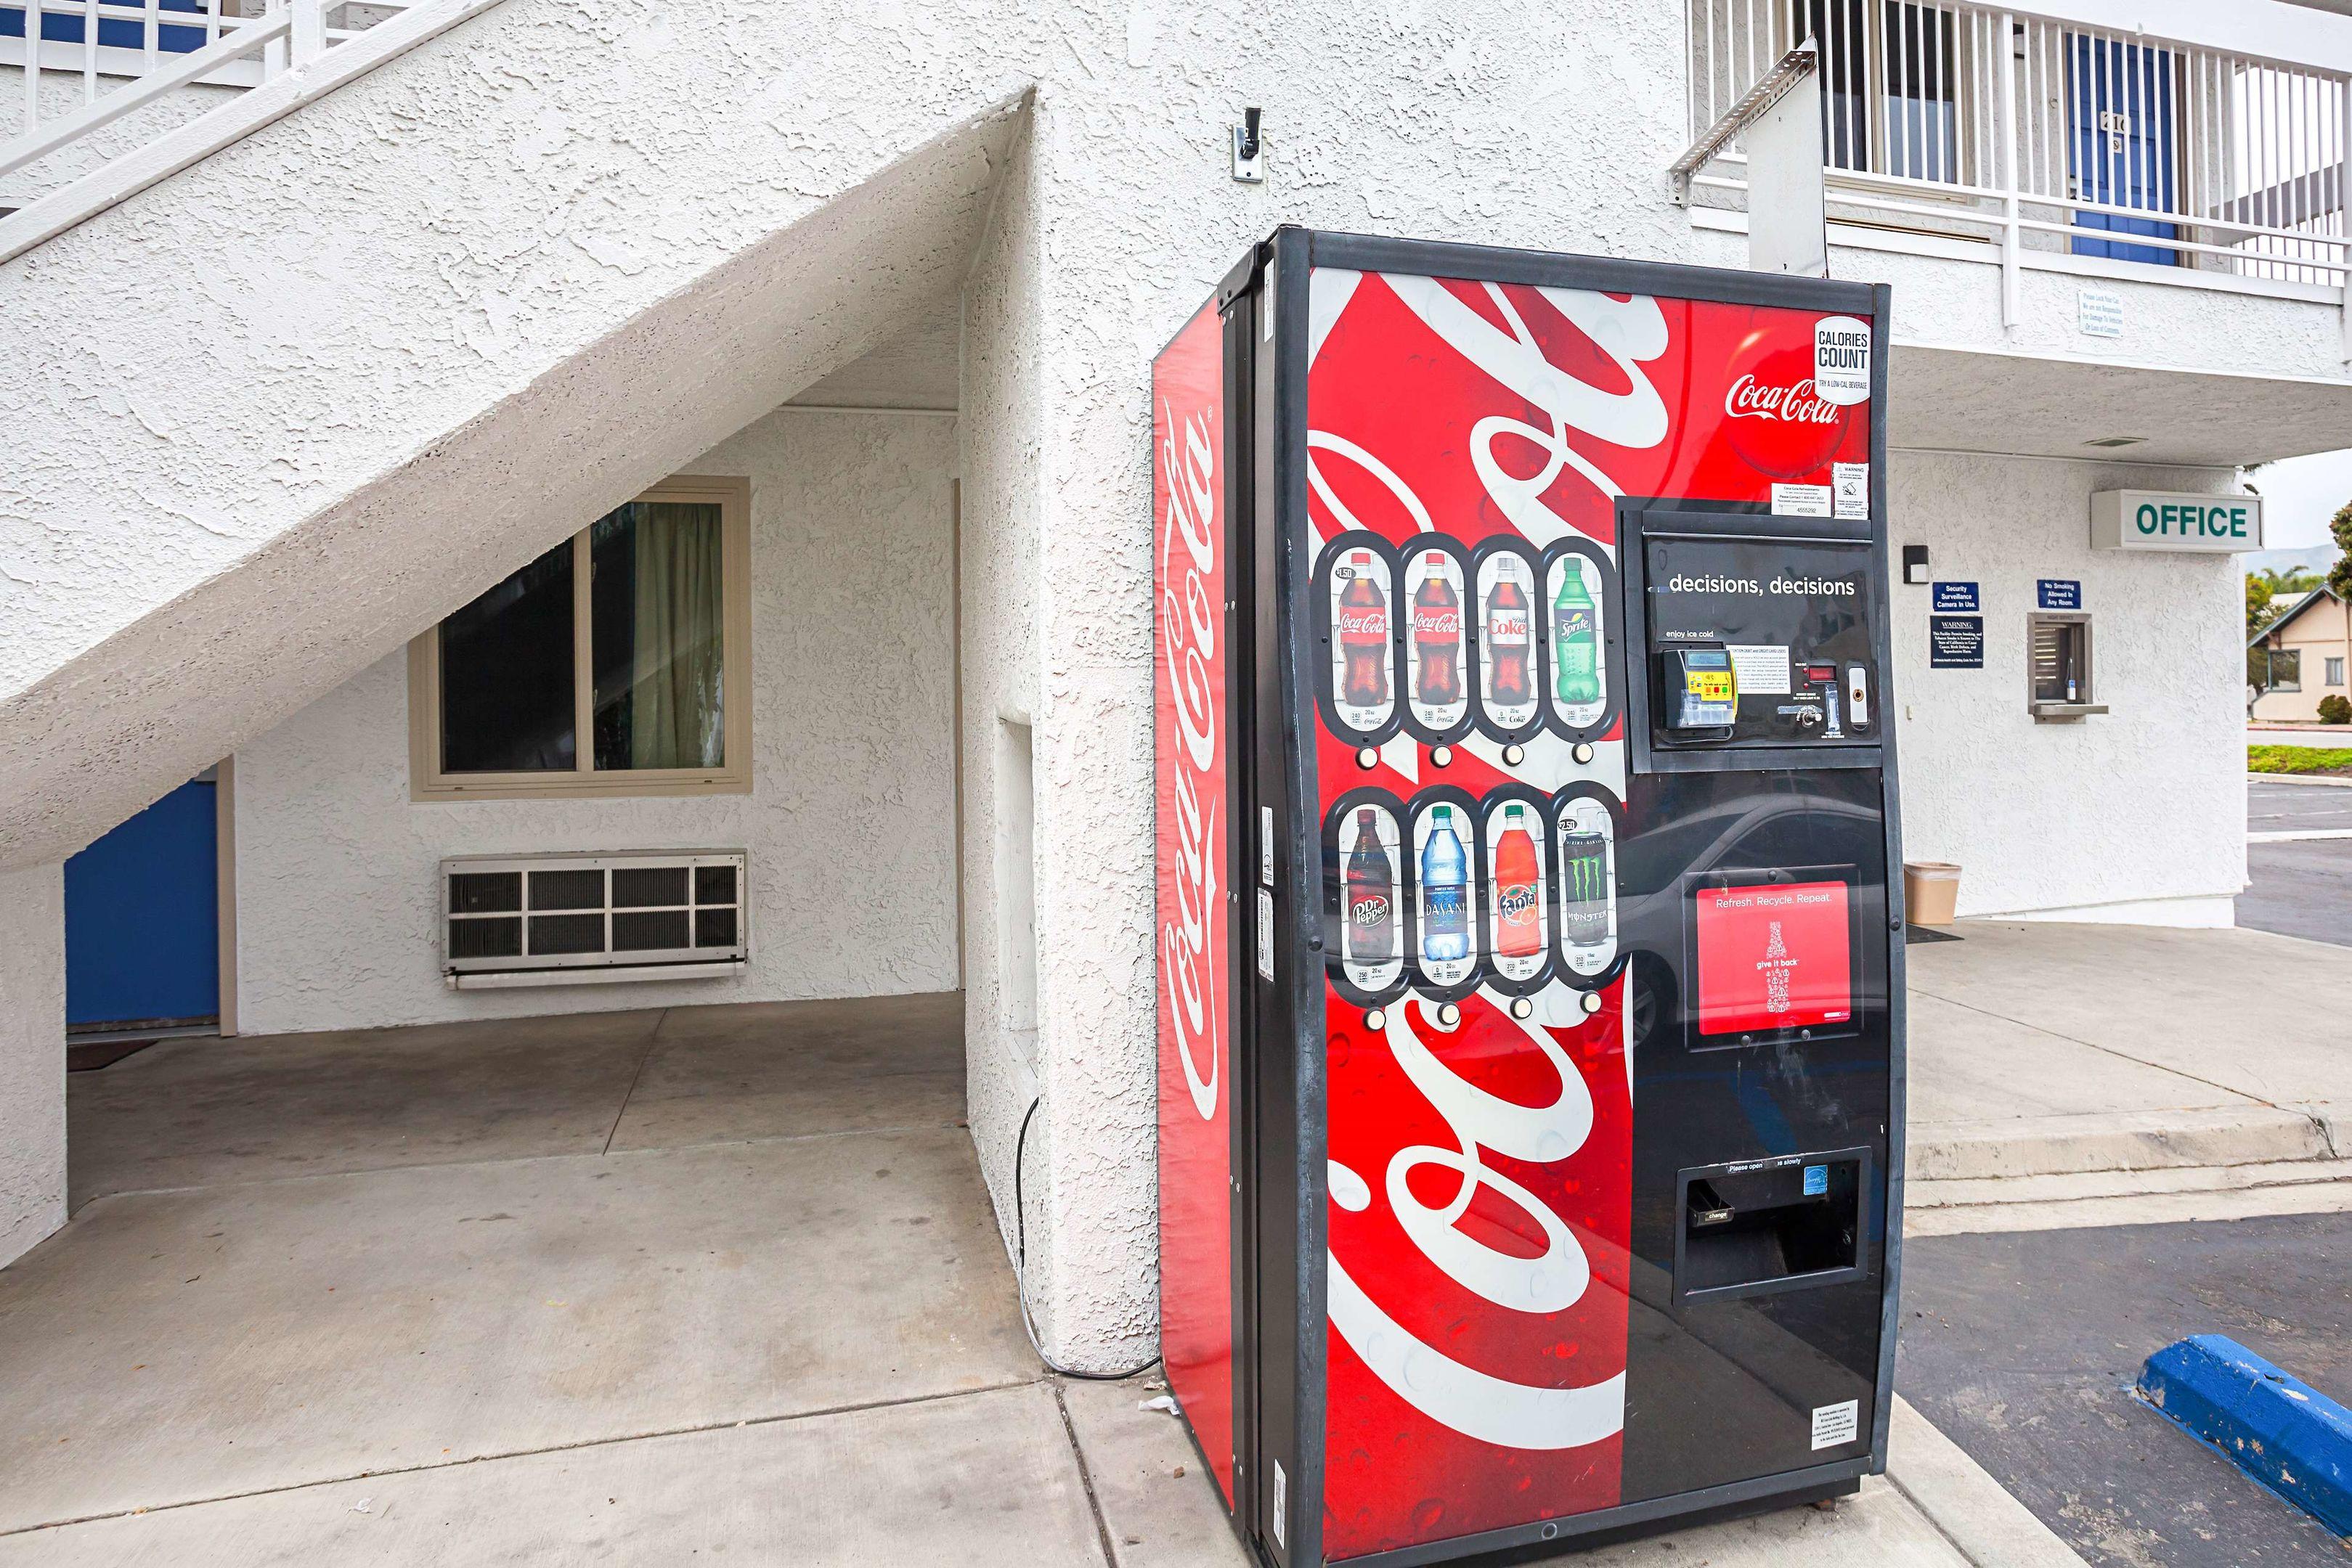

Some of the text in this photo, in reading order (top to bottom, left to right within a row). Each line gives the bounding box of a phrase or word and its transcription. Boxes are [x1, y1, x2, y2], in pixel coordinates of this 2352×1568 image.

[1818, 330, 1868, 348] CALORIES
[1818, 347, 1868, 369] COUNT
[1849, 381, 1867, 390] BEVERAGE
[2136, 504, 2247, 537] OFFICE
[1336, 568, 1352, 578] $1.50
[1669, 573, 1855, 597] decisions, decisions
[1340, 613, 1385, 634] Coca-Cola
[1415, 613, 1459, 633] Coca-Cola
[1488, 618, 1526, 634] Coke
[1562, 617, 1589, 637] Sprite
[1163, 395, 1217, 1120] Coca-Cola
[1365, 899, 1379, 912] Dr
[1426, 900, 1465, 918] DASANI
[1716, 894, 1832, 908] Refresh. Recycle. Repeat.
[1354, 902, 1387, 924] Pepper
[1568, 910, 1607, 922] MONSTER
[1757, 960, 1772, 970] give
